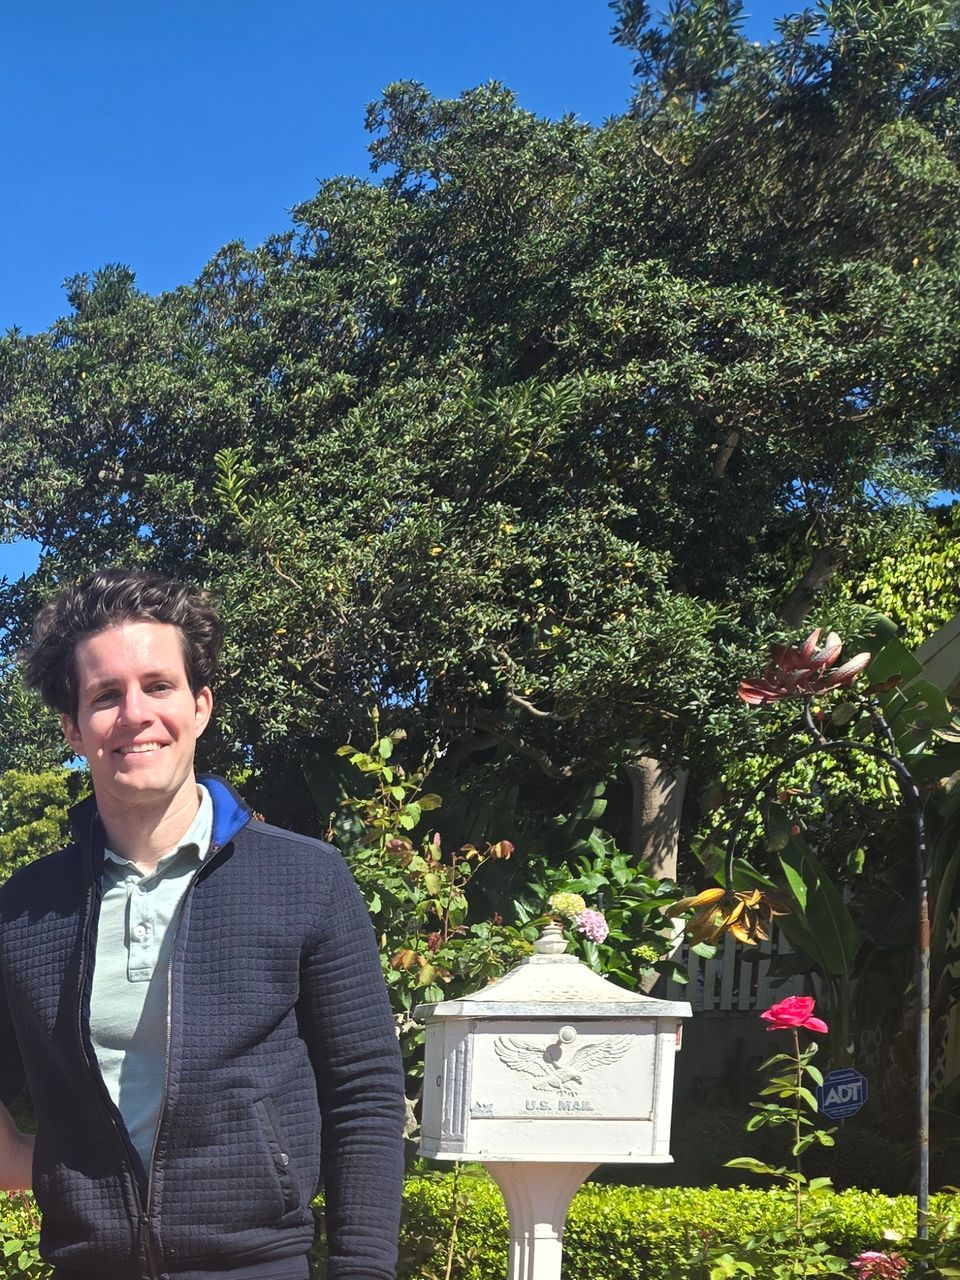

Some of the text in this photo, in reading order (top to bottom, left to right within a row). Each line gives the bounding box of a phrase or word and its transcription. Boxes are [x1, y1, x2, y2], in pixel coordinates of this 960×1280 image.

[824, 1082, 862, 1106] ADT
[525, 1100, 594, 1111] U.S. MAIL
